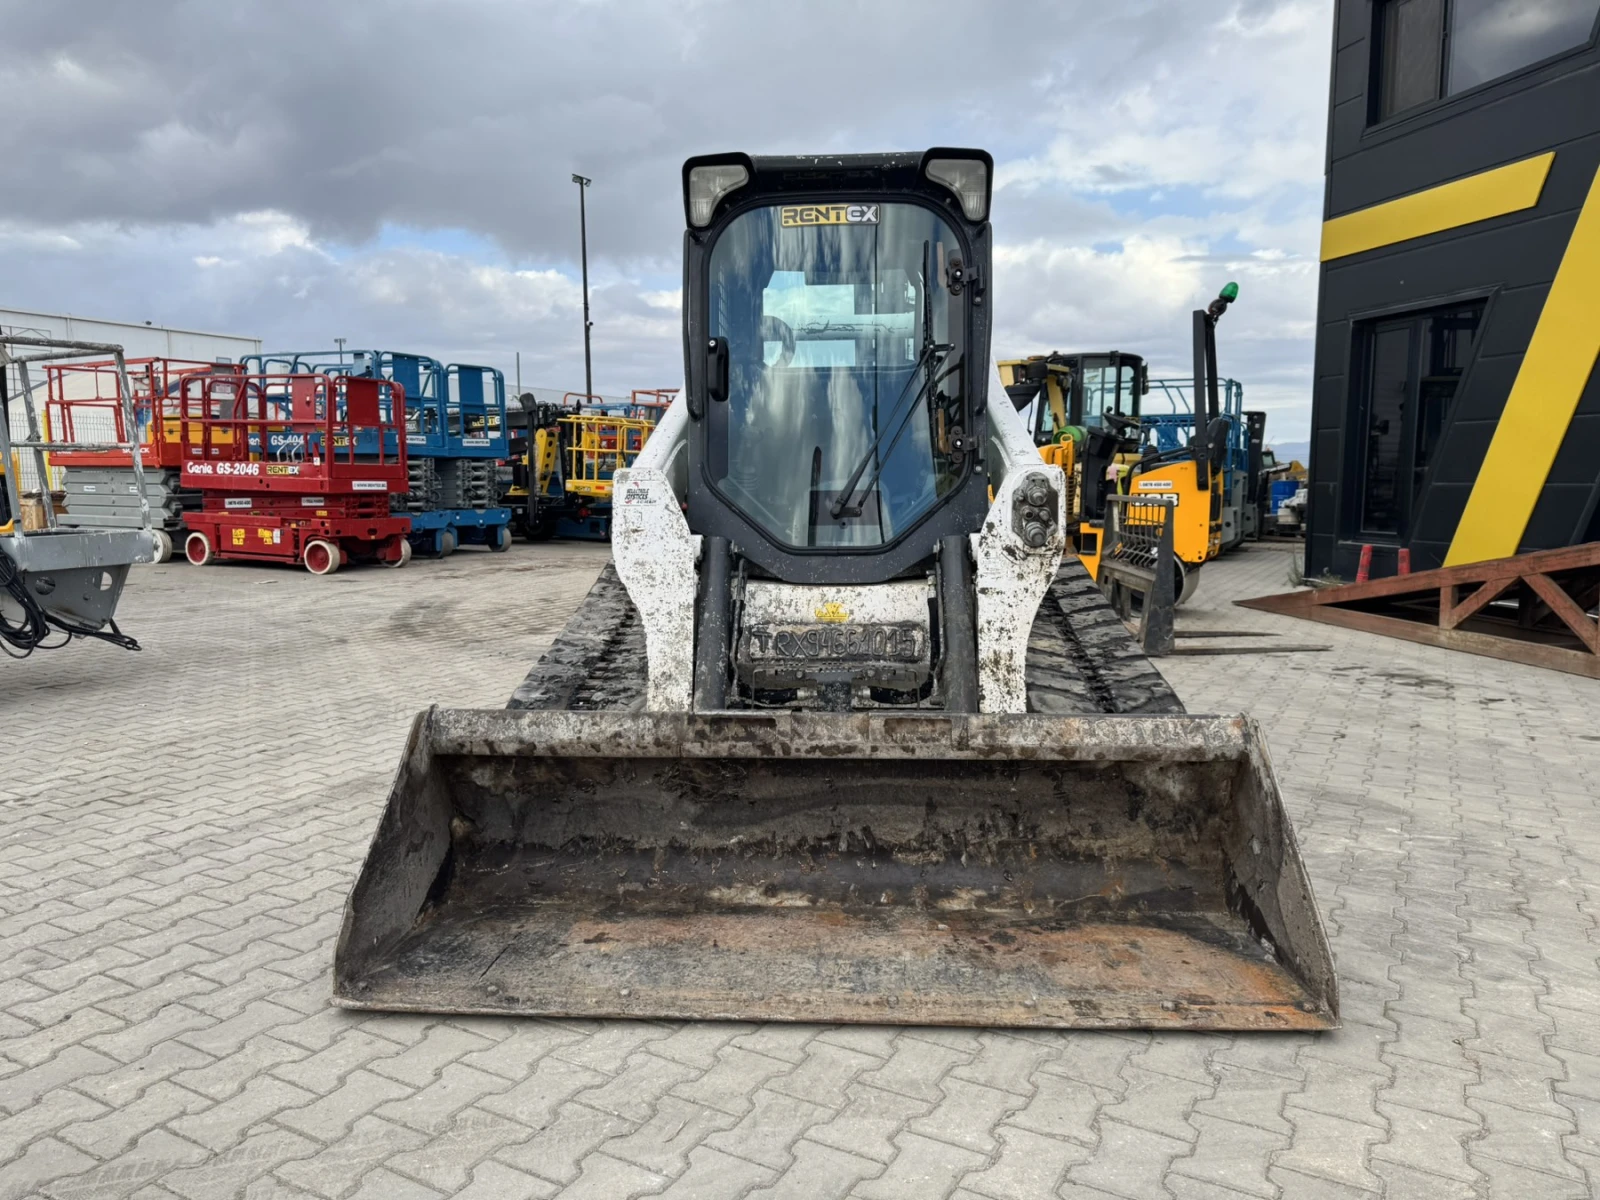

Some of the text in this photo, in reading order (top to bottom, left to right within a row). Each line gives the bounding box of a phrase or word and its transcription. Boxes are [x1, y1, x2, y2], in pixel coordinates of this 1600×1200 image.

[783, 206, 877, 224] RENTEX
[187, 461, 259, 475] Genie GS-2046
[267, 465, 299, 474] RENTEX
